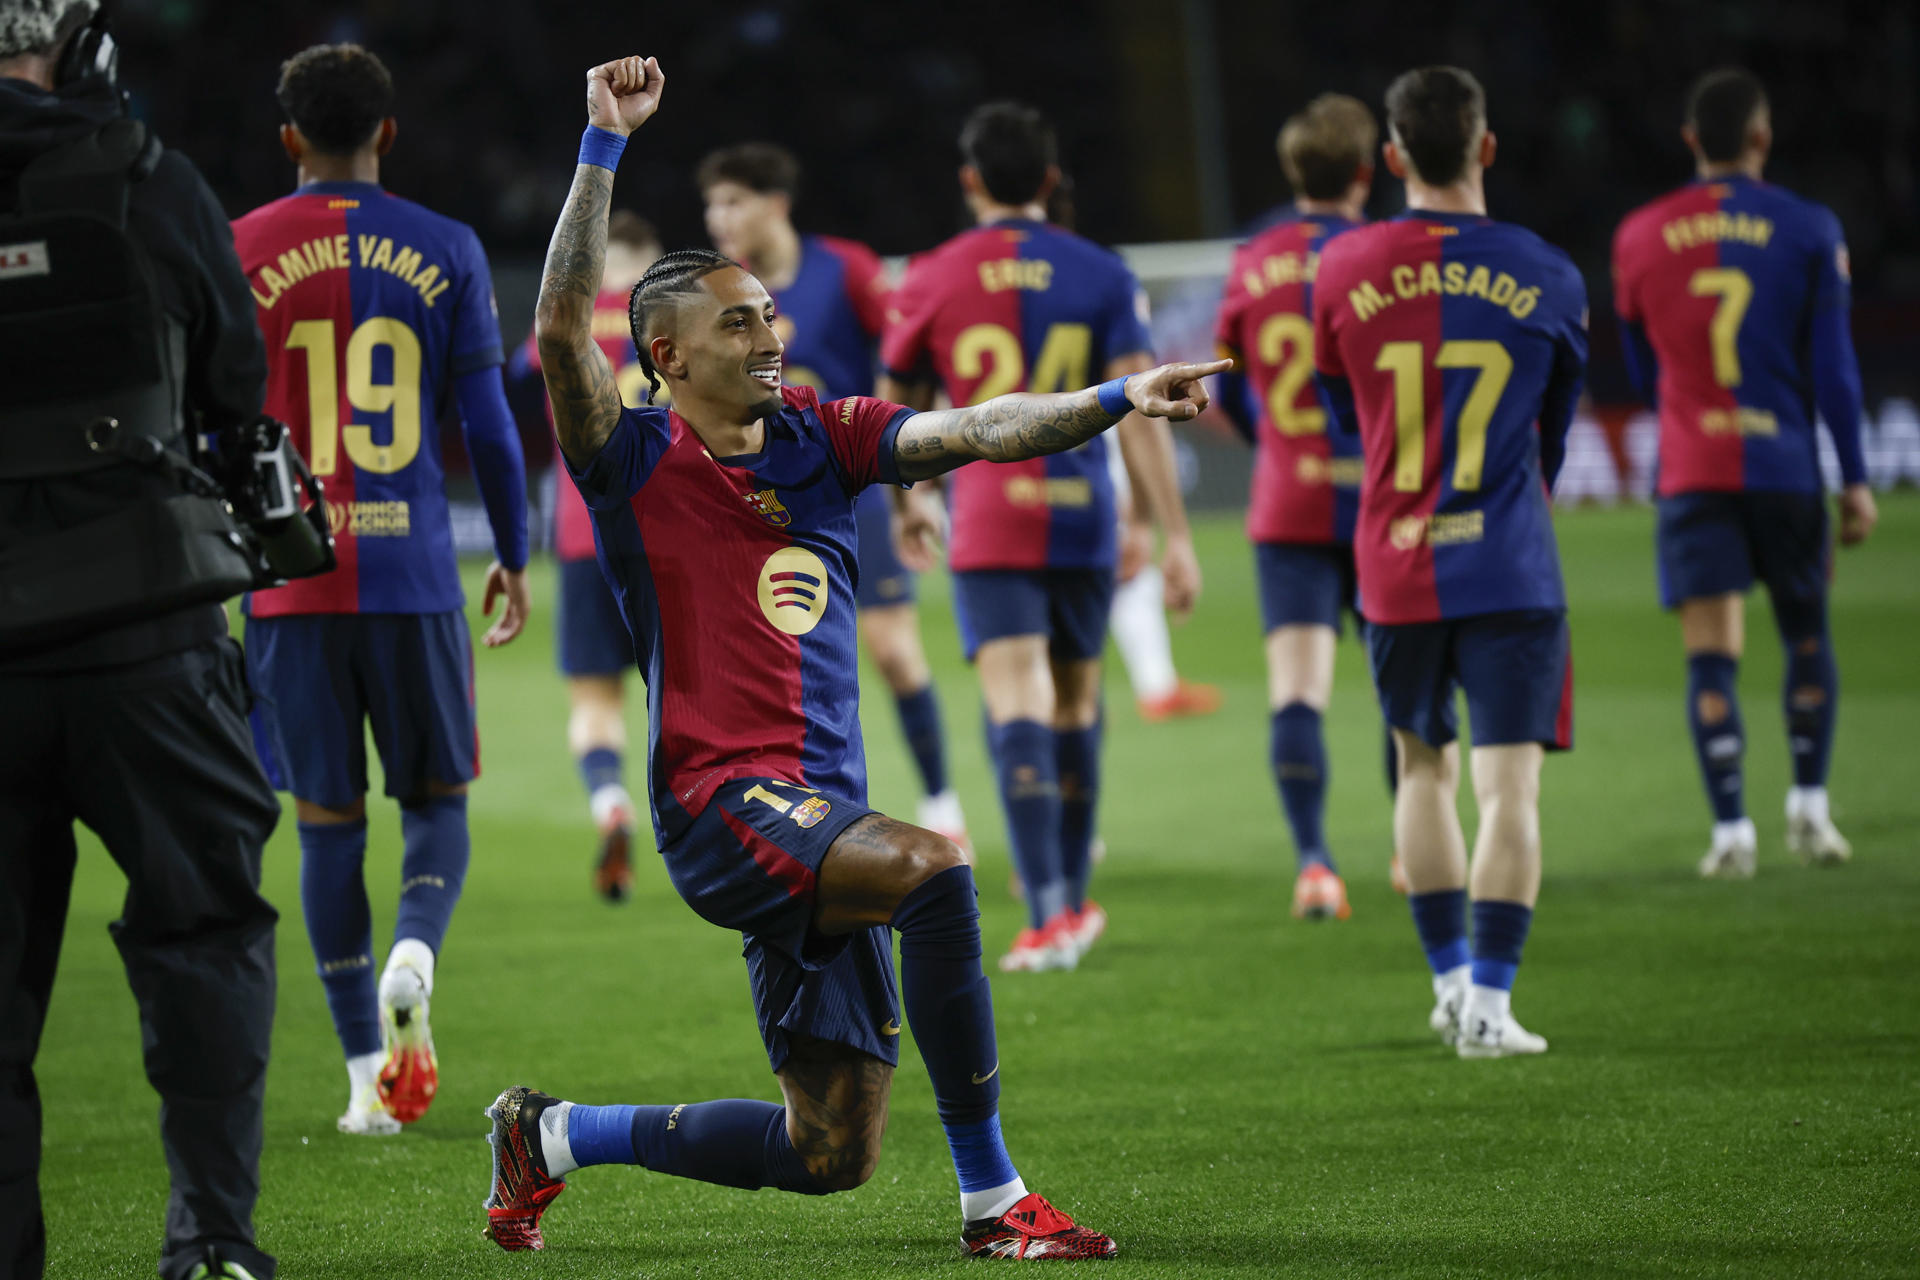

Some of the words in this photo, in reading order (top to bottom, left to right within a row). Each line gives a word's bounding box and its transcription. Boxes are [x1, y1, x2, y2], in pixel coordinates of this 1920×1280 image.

[251, 234, 351, 310] LAMINE
[358, 234, 449, 308] YAMAL
[1348, 280, 1395, 323] M.
[1391, 261, 1542, 320] CASADÓ
[1688, 266, 1754, 388] 7
[285, 316, 422, 476] 19
[1257, 311, 1327, 438] 2
[1374, 340, 1514, 492] 17
